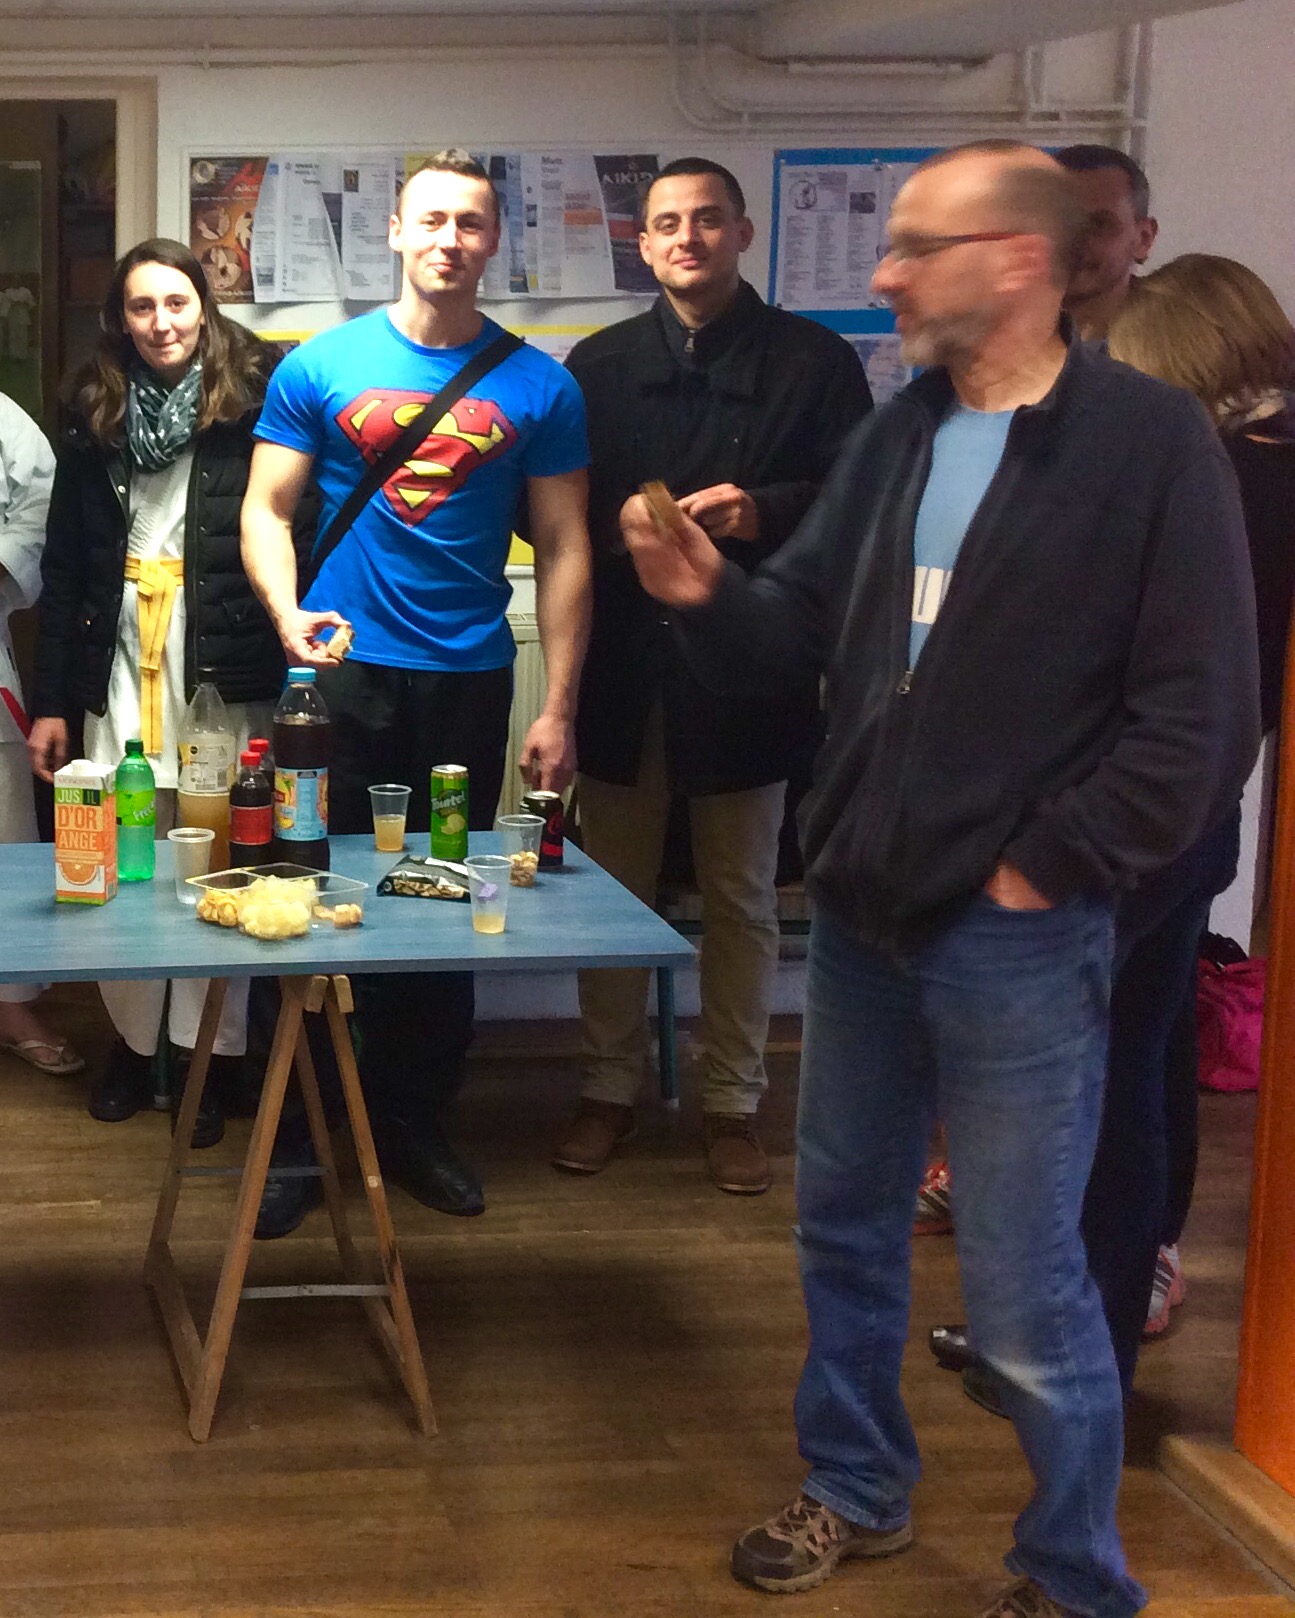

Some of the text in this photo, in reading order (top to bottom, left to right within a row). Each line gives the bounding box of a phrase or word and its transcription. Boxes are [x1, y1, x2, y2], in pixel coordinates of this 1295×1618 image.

[57, 788, 81, 804] JUS
[57, 805, 97, 829] D'OR
[58, 831, 97, 850] ANGE
